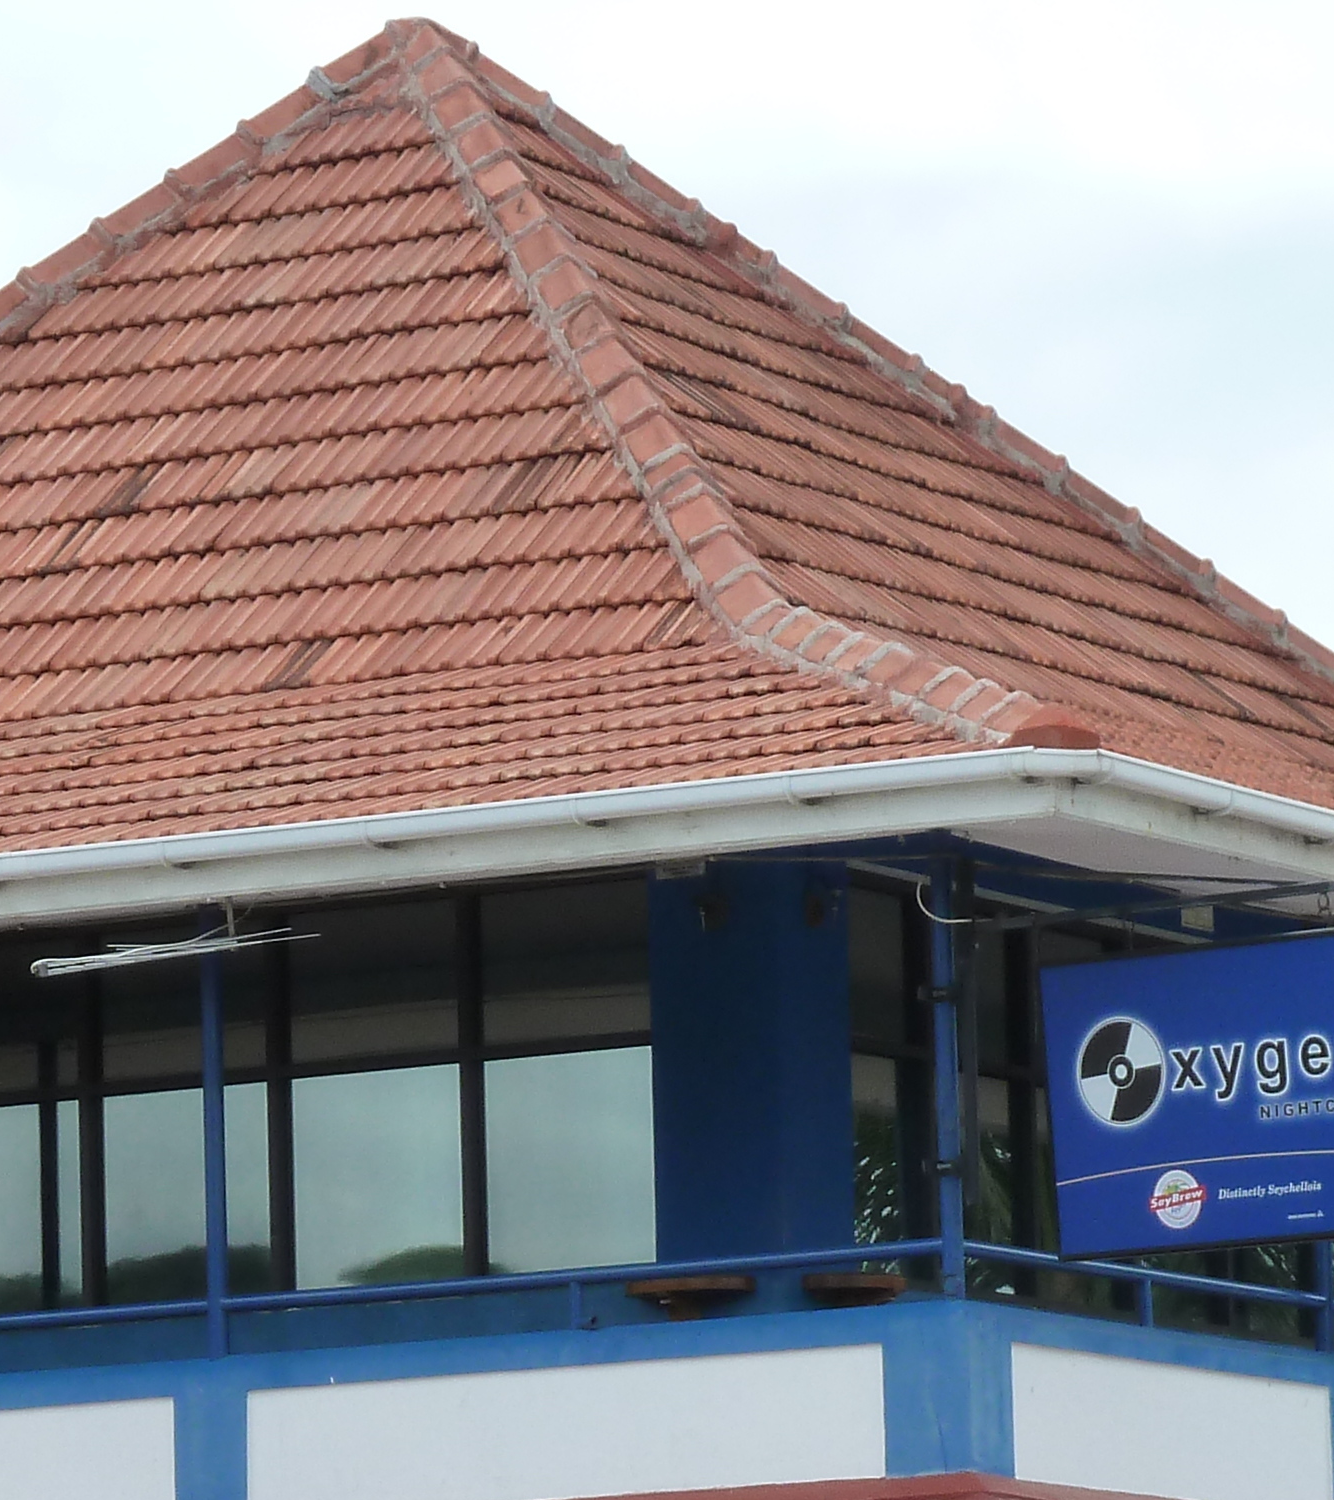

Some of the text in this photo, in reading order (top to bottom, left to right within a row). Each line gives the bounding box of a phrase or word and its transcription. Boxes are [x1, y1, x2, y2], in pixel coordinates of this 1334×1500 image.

[1150, 1188, 1204, 1209] SeyBrew
[1218, 1180, 1322, 1200] Distinctly Seychellois
